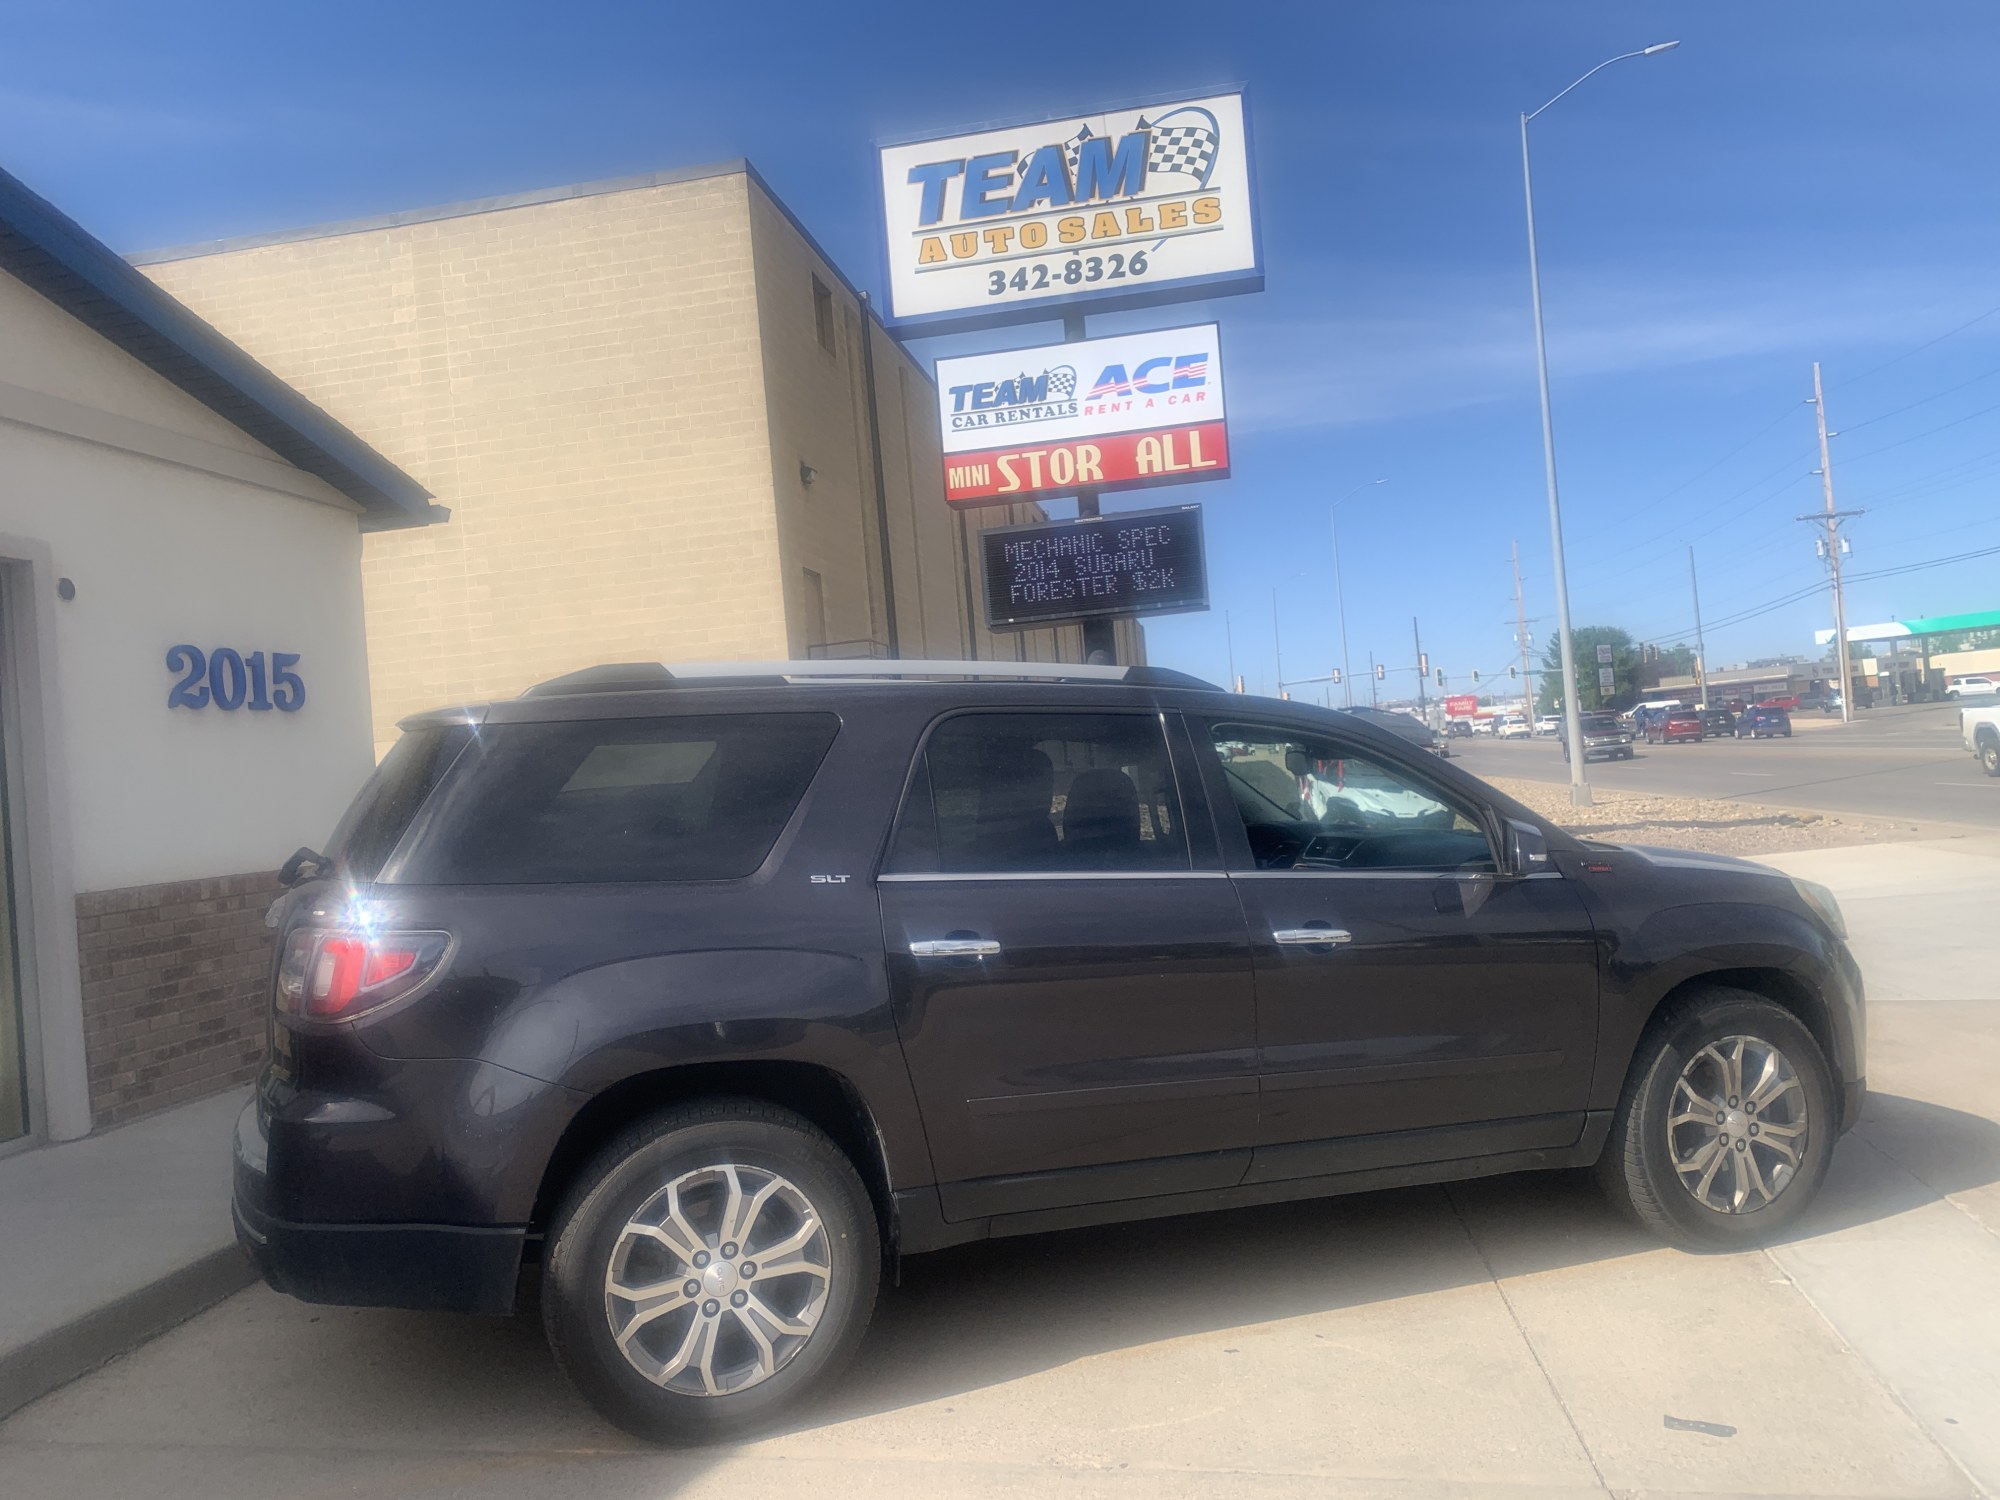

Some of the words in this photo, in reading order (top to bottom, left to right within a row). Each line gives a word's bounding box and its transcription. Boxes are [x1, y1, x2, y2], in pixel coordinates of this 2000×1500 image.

[906, 129, 1153, 228] TEAM
[918, 221, 1048, 264] AUTO
[1057, 196, 1222, 244] SALES
[987, 250, 1149, 296] 342-8326
[948, 374, 1050, 412] TEAM
[1085, 352, 1209, 401] ACE
[952, 413, 989, 429] CAR
[995, 402, 1078, 424] RENTALS
[1084, 400, 1133, 416] RENT
[1145, 399, 1155, 408] A
[1168, 391, 1206, 405] CAR
[948, 464, 990, 490] MINI
[997, 444, 1104, 492] STOR
[1136, 430, 1217, 475] ALL
[1004, 533, 1103, 562] MECHANIC
[1118, 525, 1171, 549] SPEC
[1014, 559, 1060, 582] 2014
[1074, 549, 1154, 575] SUBARU
[1010, 575, 1118, 604] FORESTER
[1132, 568, 1175, 591] $2K
[166, 644, 306, 712] 2015
[810, 874, 851, 883] SLT
